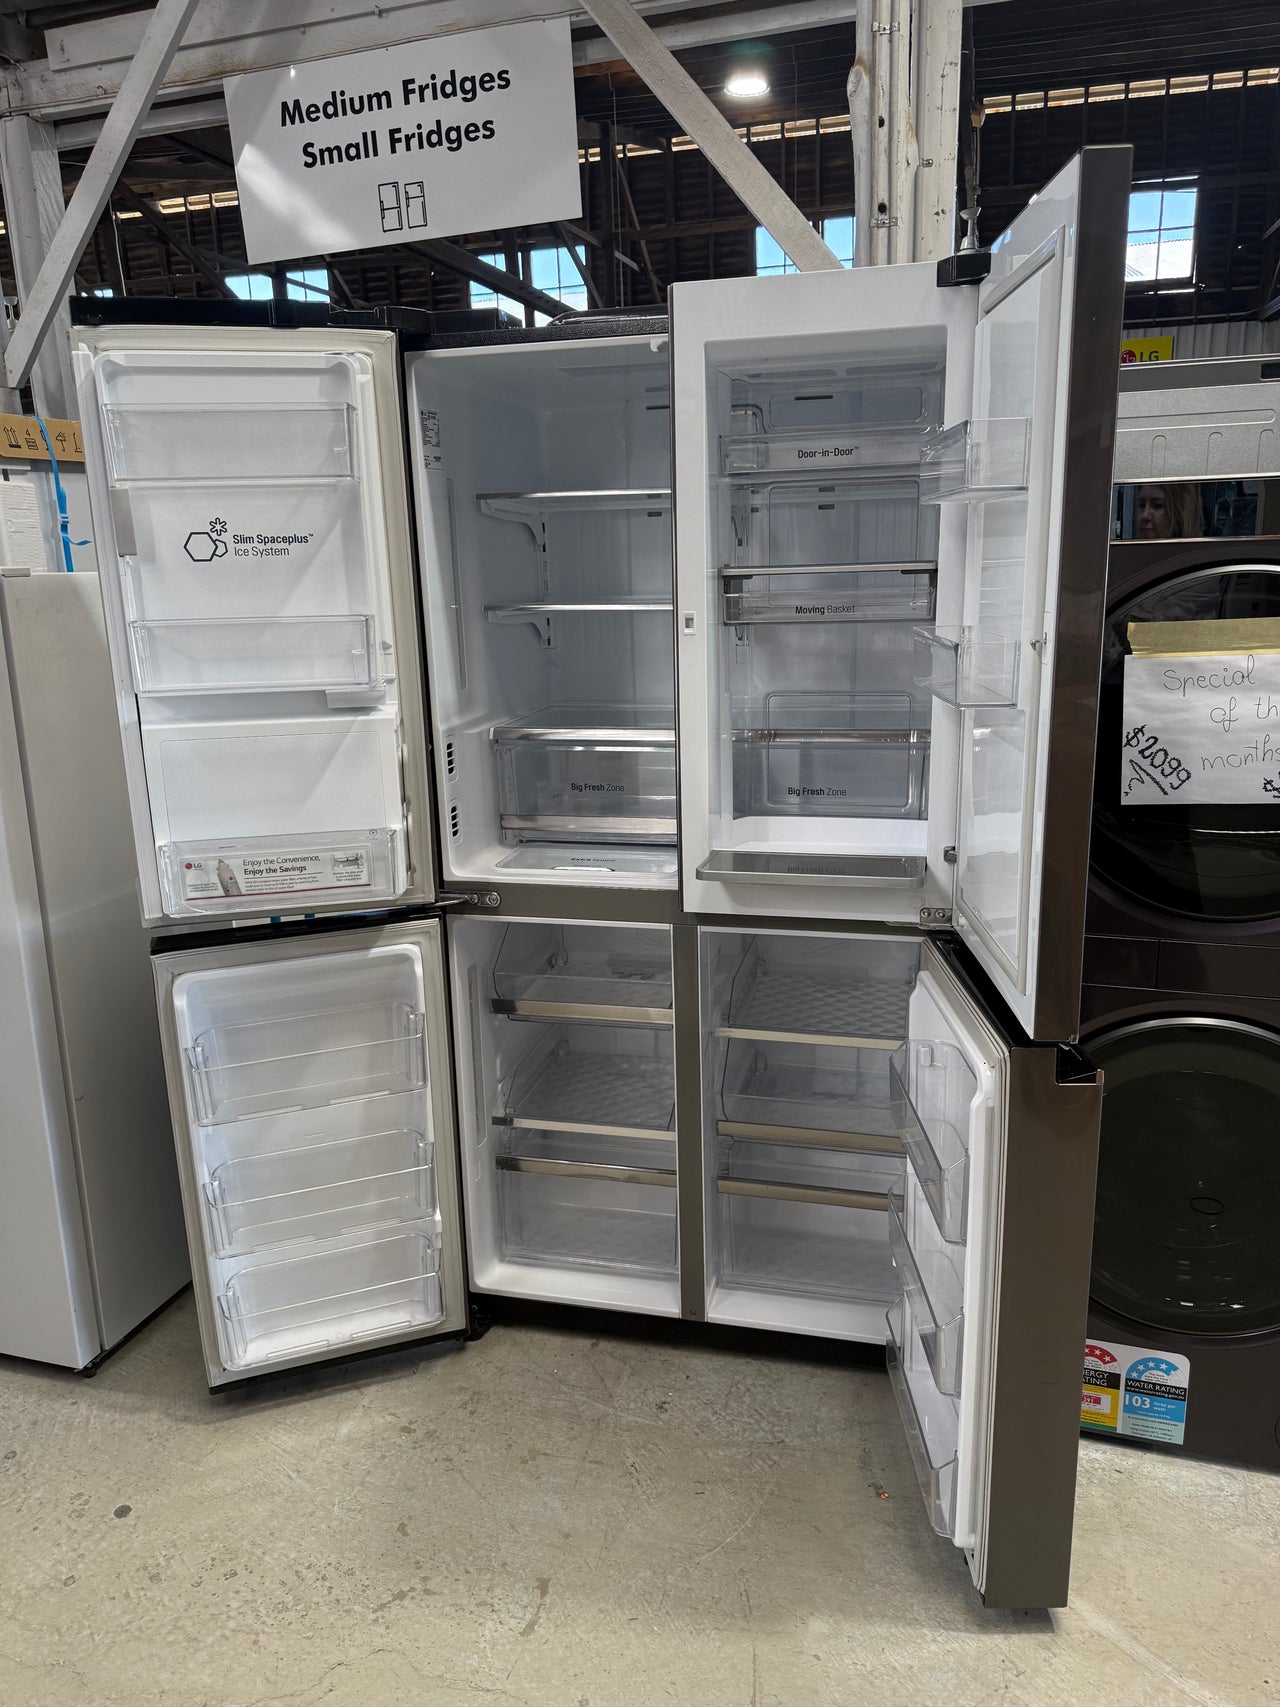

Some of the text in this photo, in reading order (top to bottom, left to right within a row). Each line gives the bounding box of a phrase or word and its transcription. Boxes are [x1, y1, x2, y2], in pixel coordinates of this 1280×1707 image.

[280, 69, 511, 127] Medium Fridges
[302, 119, 496, 168] Small Fridges
[1140, 350, 1160, 362] LG
[232, 534, 255, 545] Slim
[234, 546, 290, 558] Ice System
[795, 604, 856, 616] Moving Basket
[1163, 653, 1257, 698] Special
[1209, 695, 1280, 733] of th
[1122, 723, 1192, 791] $2099
[571, 782, 625, 793] Big Fresh Zone
[787, 786, 847, 797] Big Fresh Zone
[242, 854, 321, 868] Enjoy the Convenience,
[243, 865, 307, 877] Enjoy the Savings
[1083, 1368, 1109, 1380] ERGY
[1082, 1376, 1108, 1387] TING
[1126, 1380, 1154, 1390] WATER
[1155, 1385, 1185, 1396] RATING
[1124, 1394, 1151, 1409] 103
